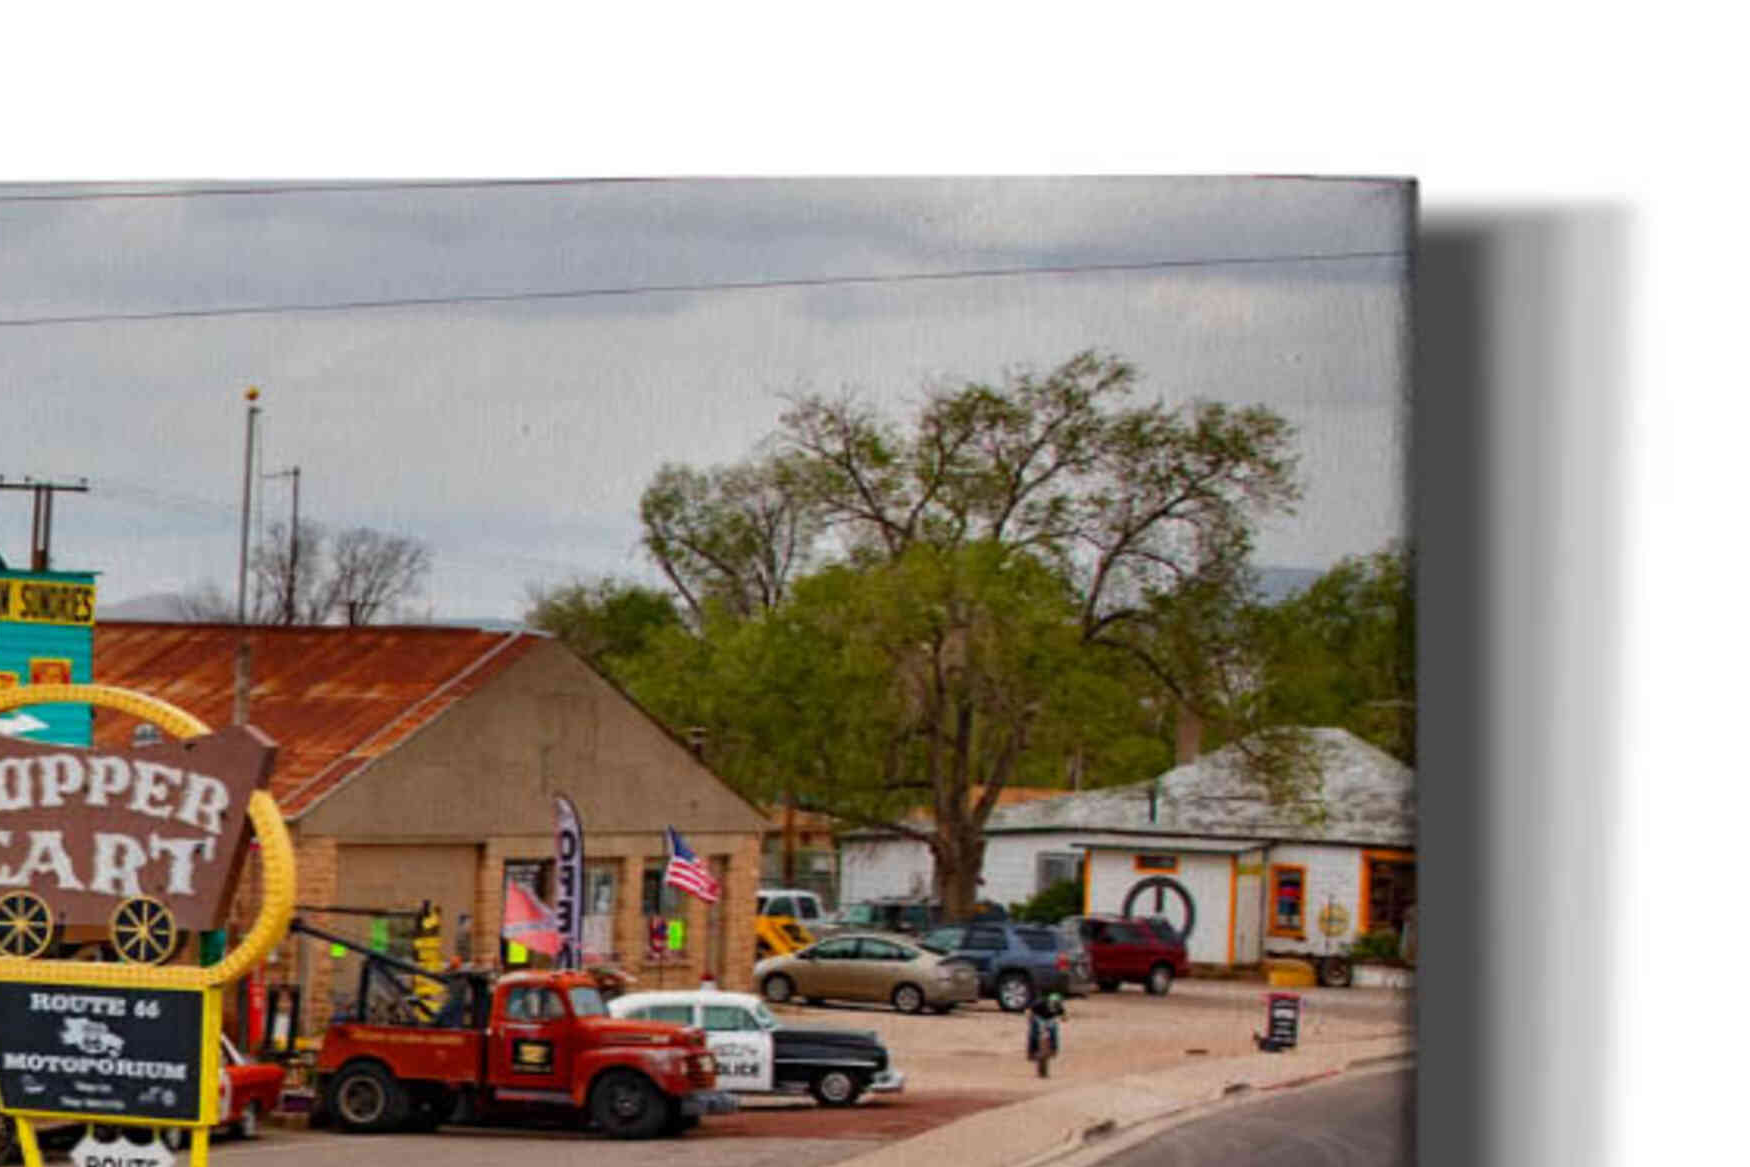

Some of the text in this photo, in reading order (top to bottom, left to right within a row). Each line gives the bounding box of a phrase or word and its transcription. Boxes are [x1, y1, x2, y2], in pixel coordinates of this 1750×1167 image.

[20, 583, 93, 622] SUNDRIES
[30, 993, 160, 1019] ROUTE 66
[3, 1052, 188, 1080] MOTOPORIUM
[714, 1062, 759, 1077] OLICE
